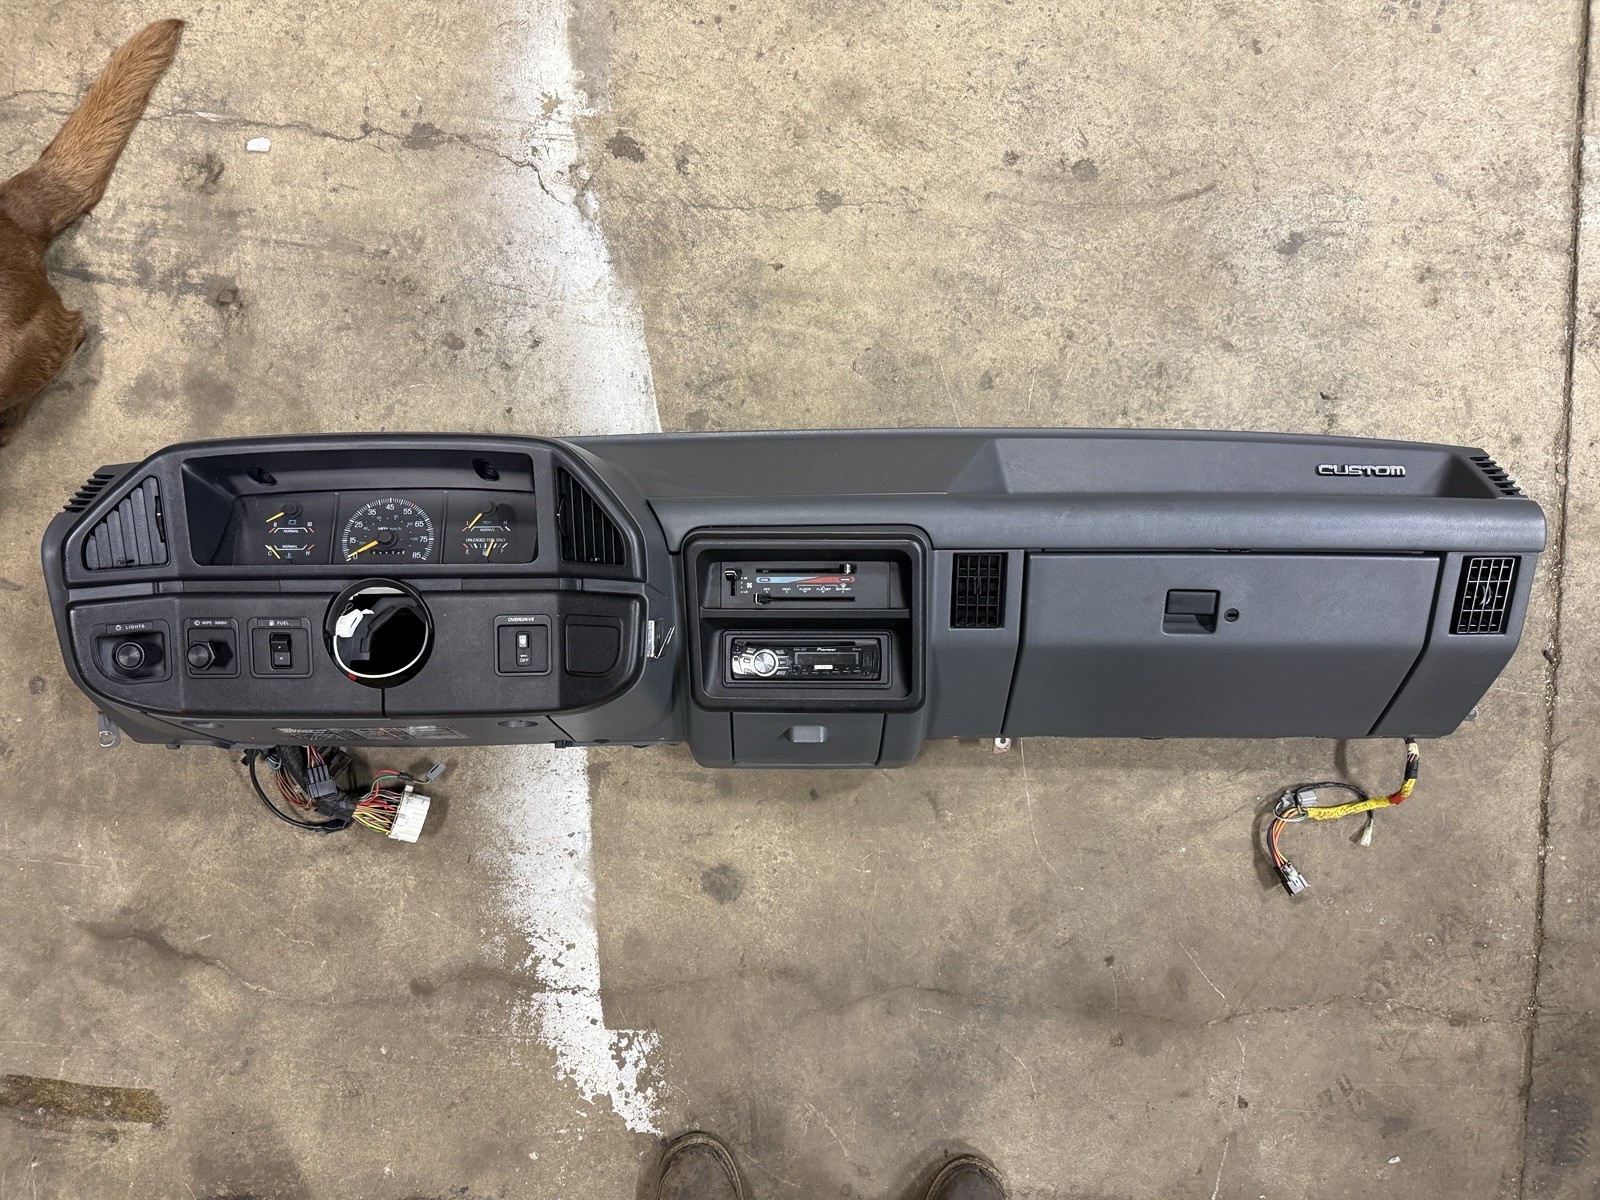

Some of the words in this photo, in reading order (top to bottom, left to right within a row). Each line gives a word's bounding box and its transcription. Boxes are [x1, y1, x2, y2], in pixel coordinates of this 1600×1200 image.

[1318, 464, 1406, 476] CUSTOM
[386, 503, 395, 511] 45
[403, 507, 412, 515] 55
[367, 508, 377, 516] 35
[414, 520, 424, 528] 65
[349, 536, 357, 544] 15
[412, 551, 421, 559] 85
